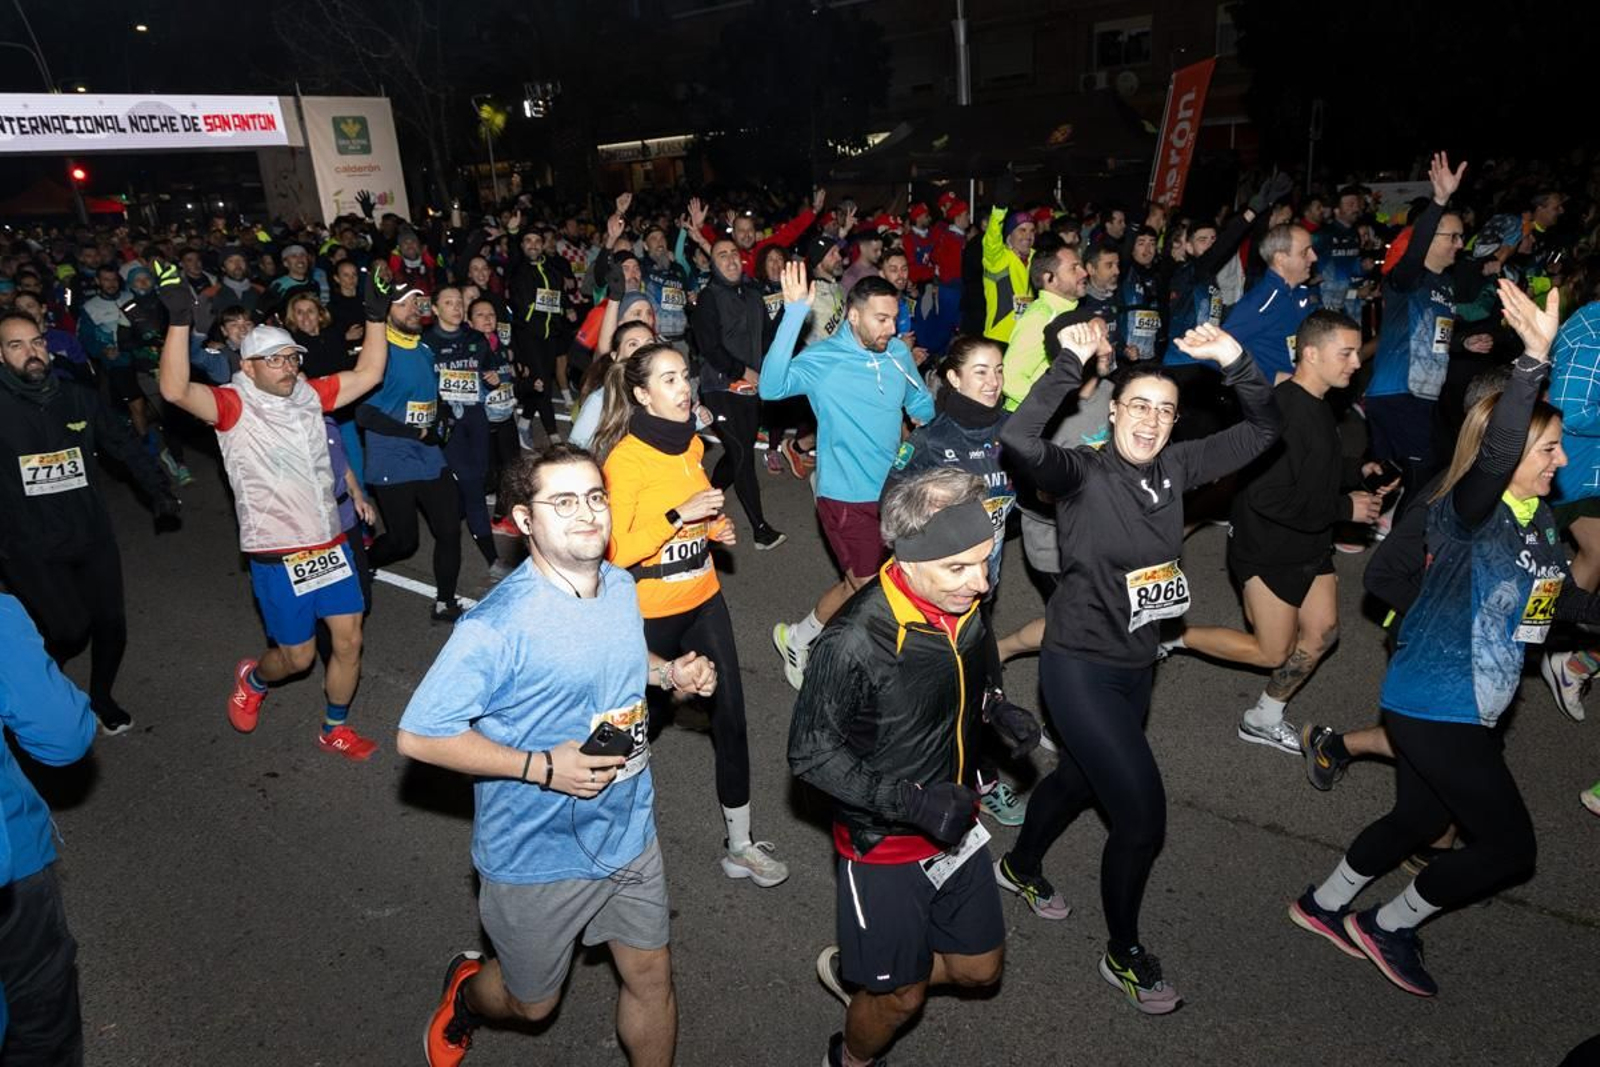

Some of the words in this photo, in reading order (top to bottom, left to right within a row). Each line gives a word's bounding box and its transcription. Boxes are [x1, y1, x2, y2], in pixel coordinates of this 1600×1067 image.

[128, 114, 179, 133] NOCHE
[181, 114, 202, 132] DE
[203, 113, 231, 132] SAN
[443, 379, 477, 391] 8423
[27, 460, 79, 480] 7713
[293, 551, 340, 578] 6296
[1136, 576, 1185, 609] 8066
